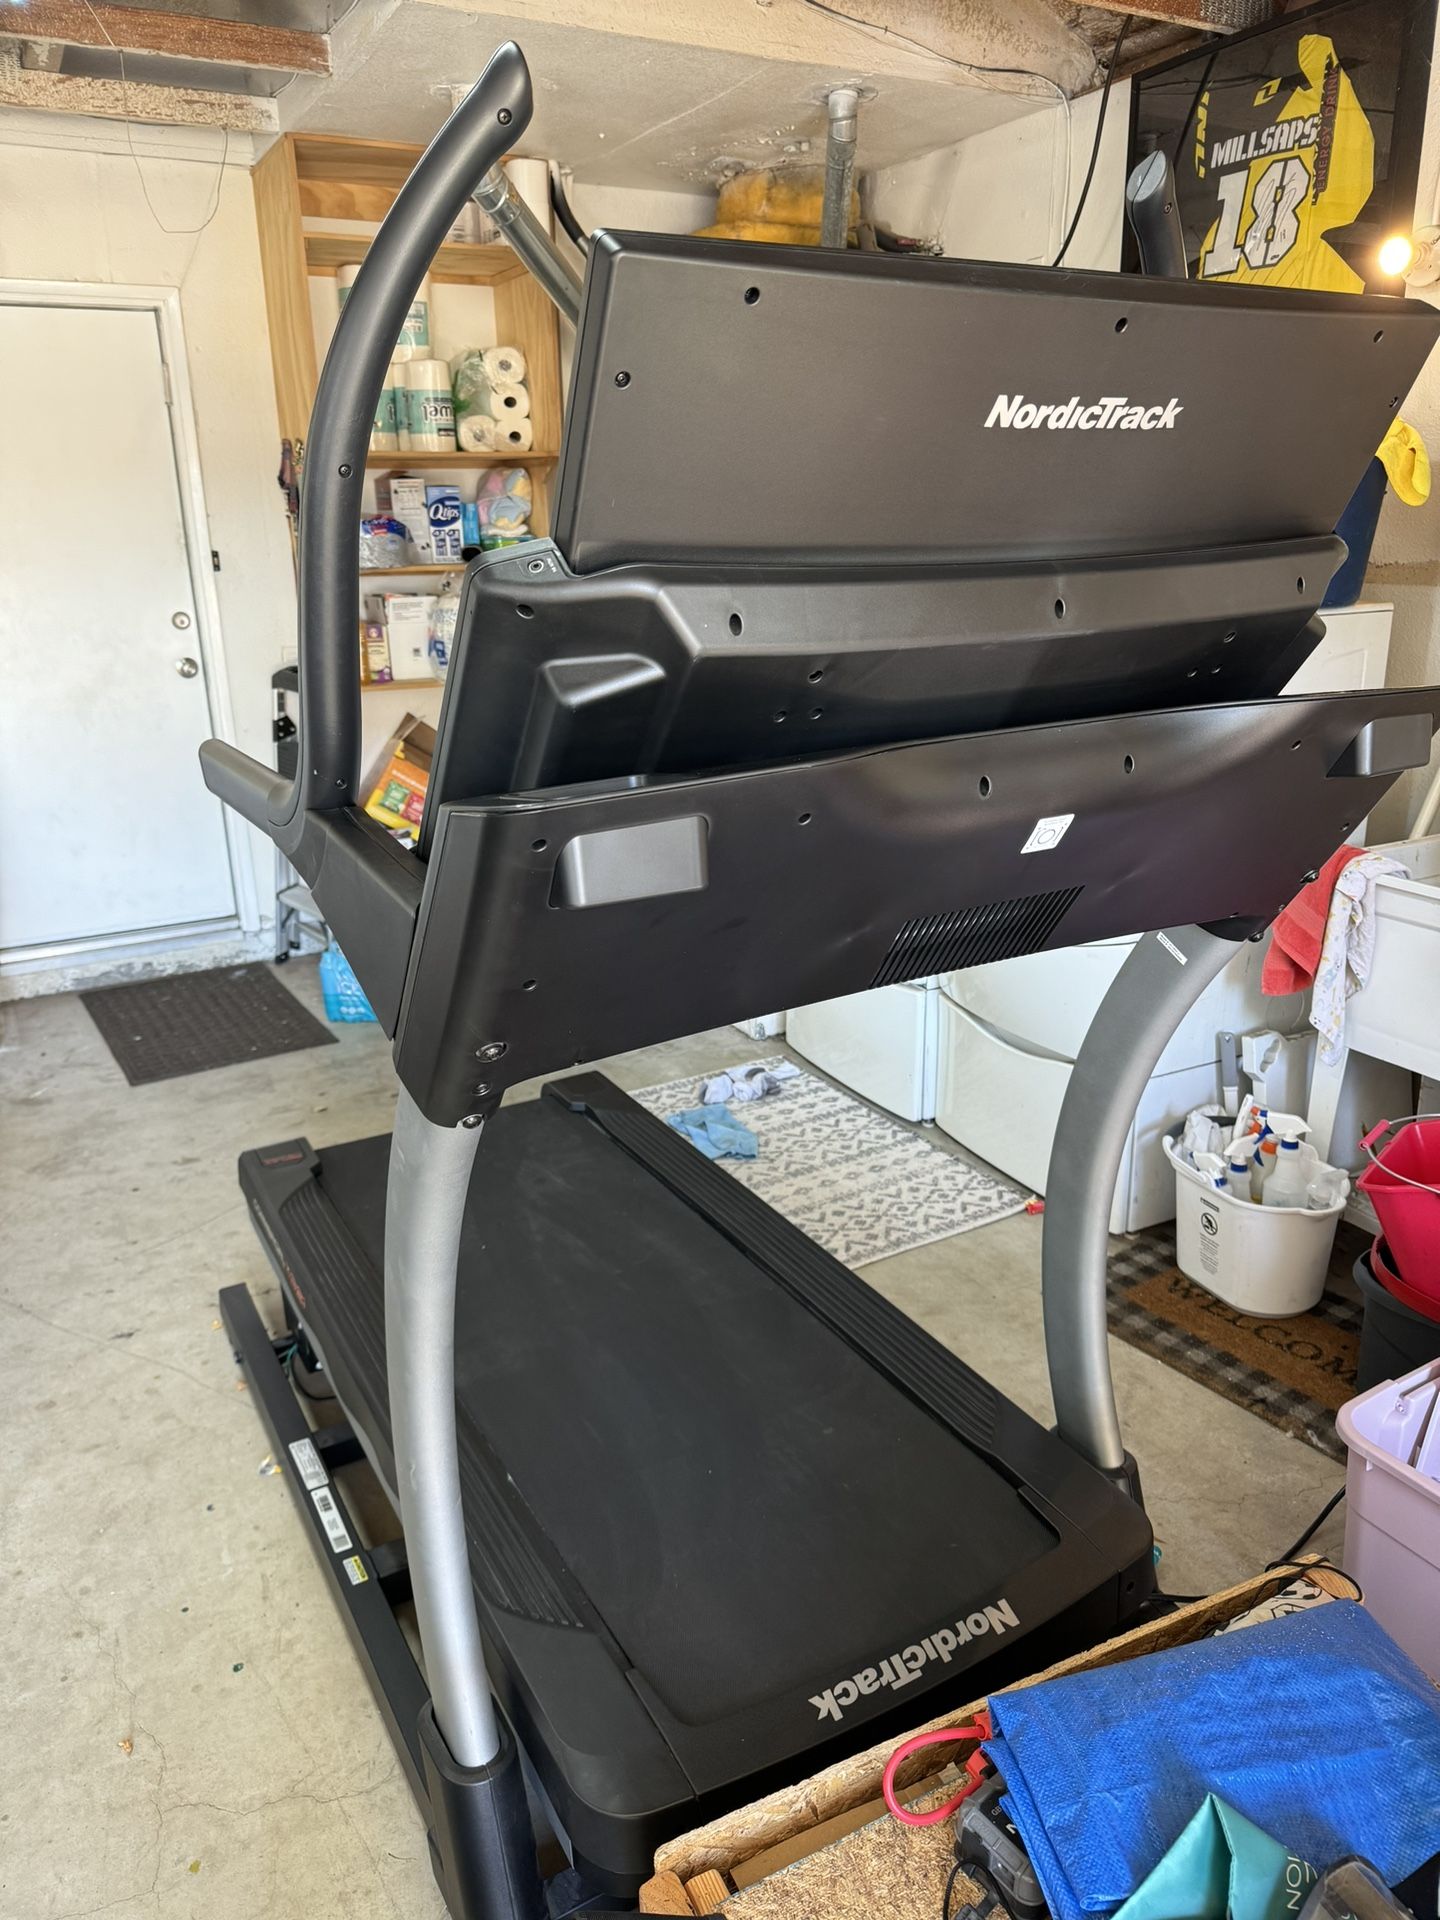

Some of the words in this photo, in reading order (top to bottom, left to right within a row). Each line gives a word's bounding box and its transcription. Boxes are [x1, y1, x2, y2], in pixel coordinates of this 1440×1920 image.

[1210, 115, 1321, 169] MILLSAPS
[1316, 126, 1330, 192] ENERGY
[1324, 65, 1339, 117] DRINK
[1202, 158, 1310, 276] 18
[983, 394, 1185, 430] NordicTrack
[807, 1598, 1021, 1722] NordicTrack
